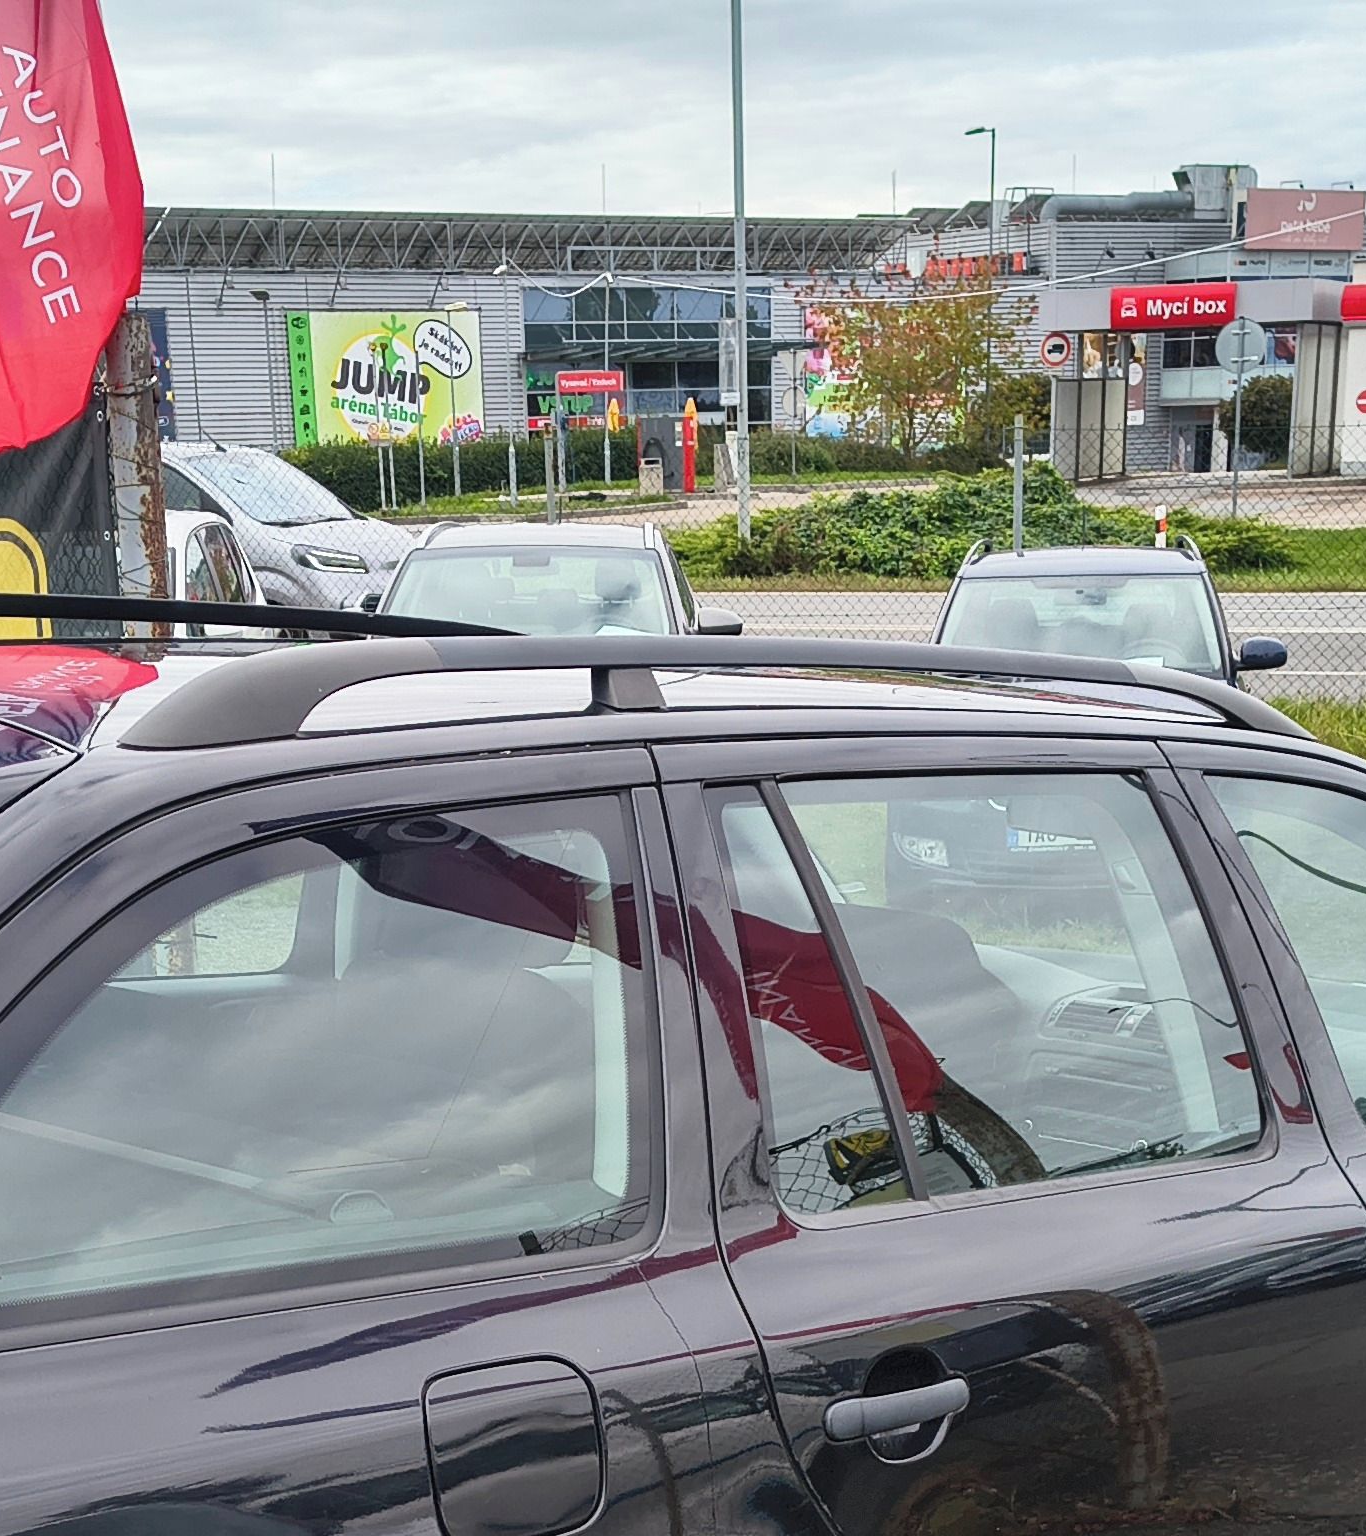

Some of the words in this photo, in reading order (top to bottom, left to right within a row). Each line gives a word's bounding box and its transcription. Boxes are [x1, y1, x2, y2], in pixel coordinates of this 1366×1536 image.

[2, 46, 82, 208] AUTO
[1147, 297, 1189, 320] Mycí
[1194, 297, 1227, 315] box
[331, 358, 430, 404] JUMP
[331, 394, 378, 417] aréna
[380, 402, 427, 425] Tábor
